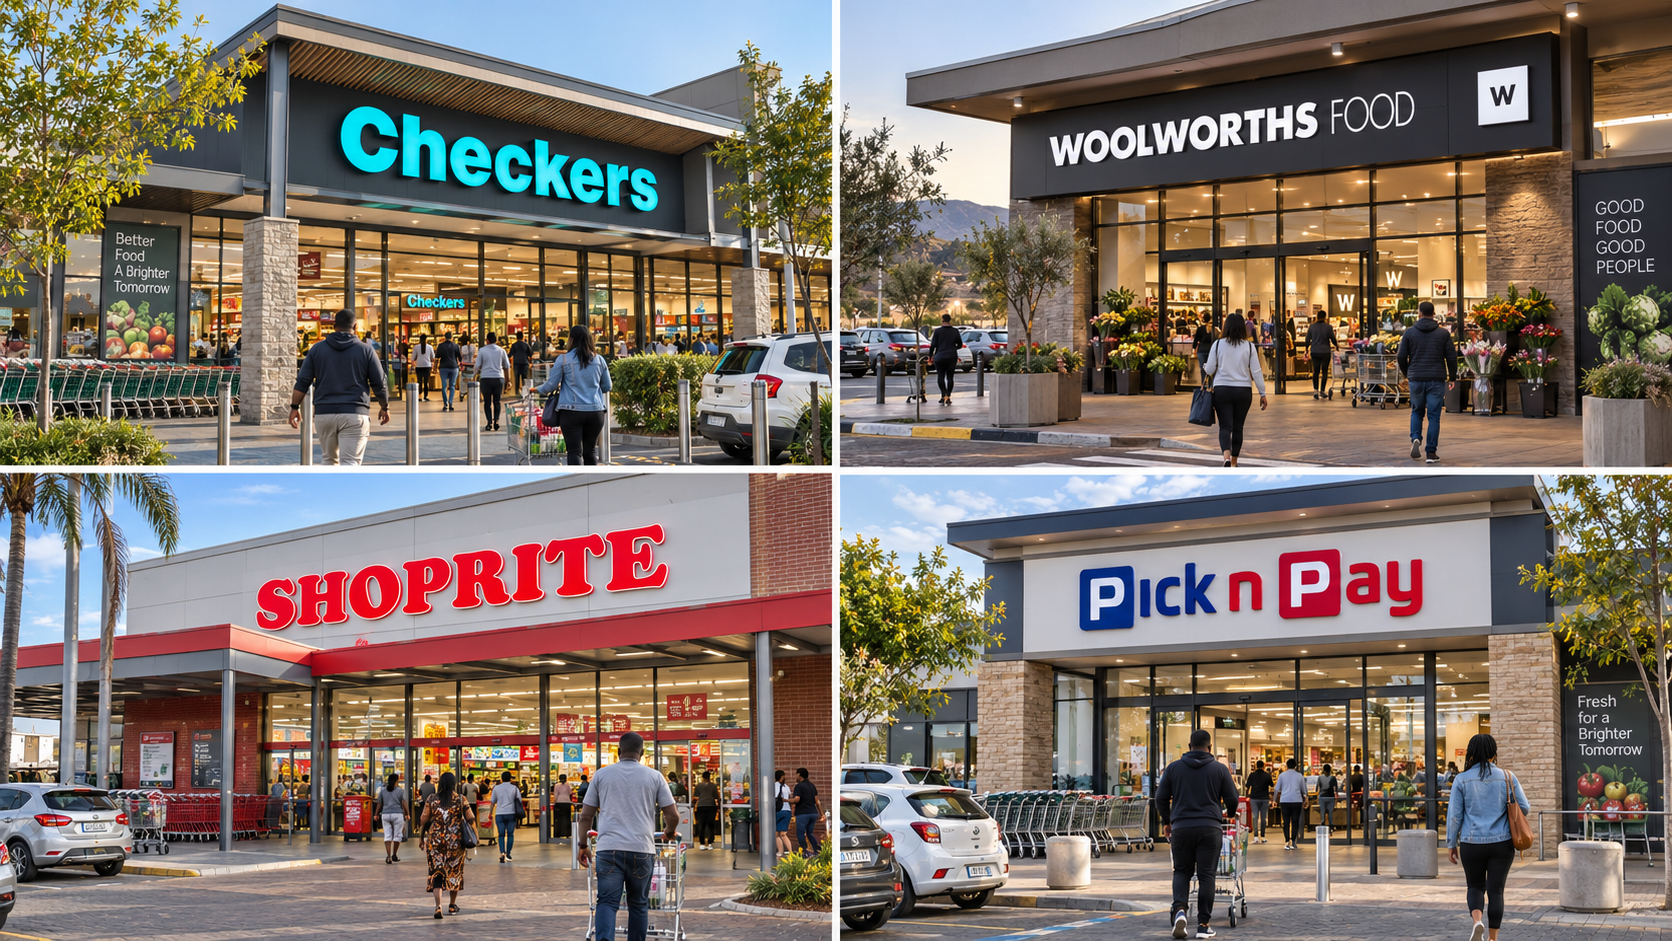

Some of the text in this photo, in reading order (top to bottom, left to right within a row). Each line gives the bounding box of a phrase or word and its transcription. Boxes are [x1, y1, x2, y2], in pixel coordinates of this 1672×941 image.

[1489, 84, 1516, 106] W
[1049, 90, 1415, 167] WOOLWORTHS FOOD
[340, 106, 659, 212] Checkers
[1595, 198, 1645, 216] GOOD
[1596, 218, 1642, 235] FOOD
[116, 232, 155, 247] Better
[1596, 238, 1646, 255] GOOD
[115, 248, 145, 262] Food
[114, 264, 170, 281] A Brighter
[1597, 258, 1656, 274] PEOPLE
[113, 280, 170, 294] Tomorrow
[1385, 271, 1403, 288] W
[407, 294, 466, 309] Checkers
[1336, 294, 1355, 311] W
[255, 523, 670, 631] SHOPRITE
[1085, 556, 1424, 626] Pick n Pay
[1577, 694, 1617, 708] Fresh
[1578, 711, 1610, 724] for a
[1578, 727, 1632, 742] Brighter
[1578, 743, 1643, 756] Tomorrow
